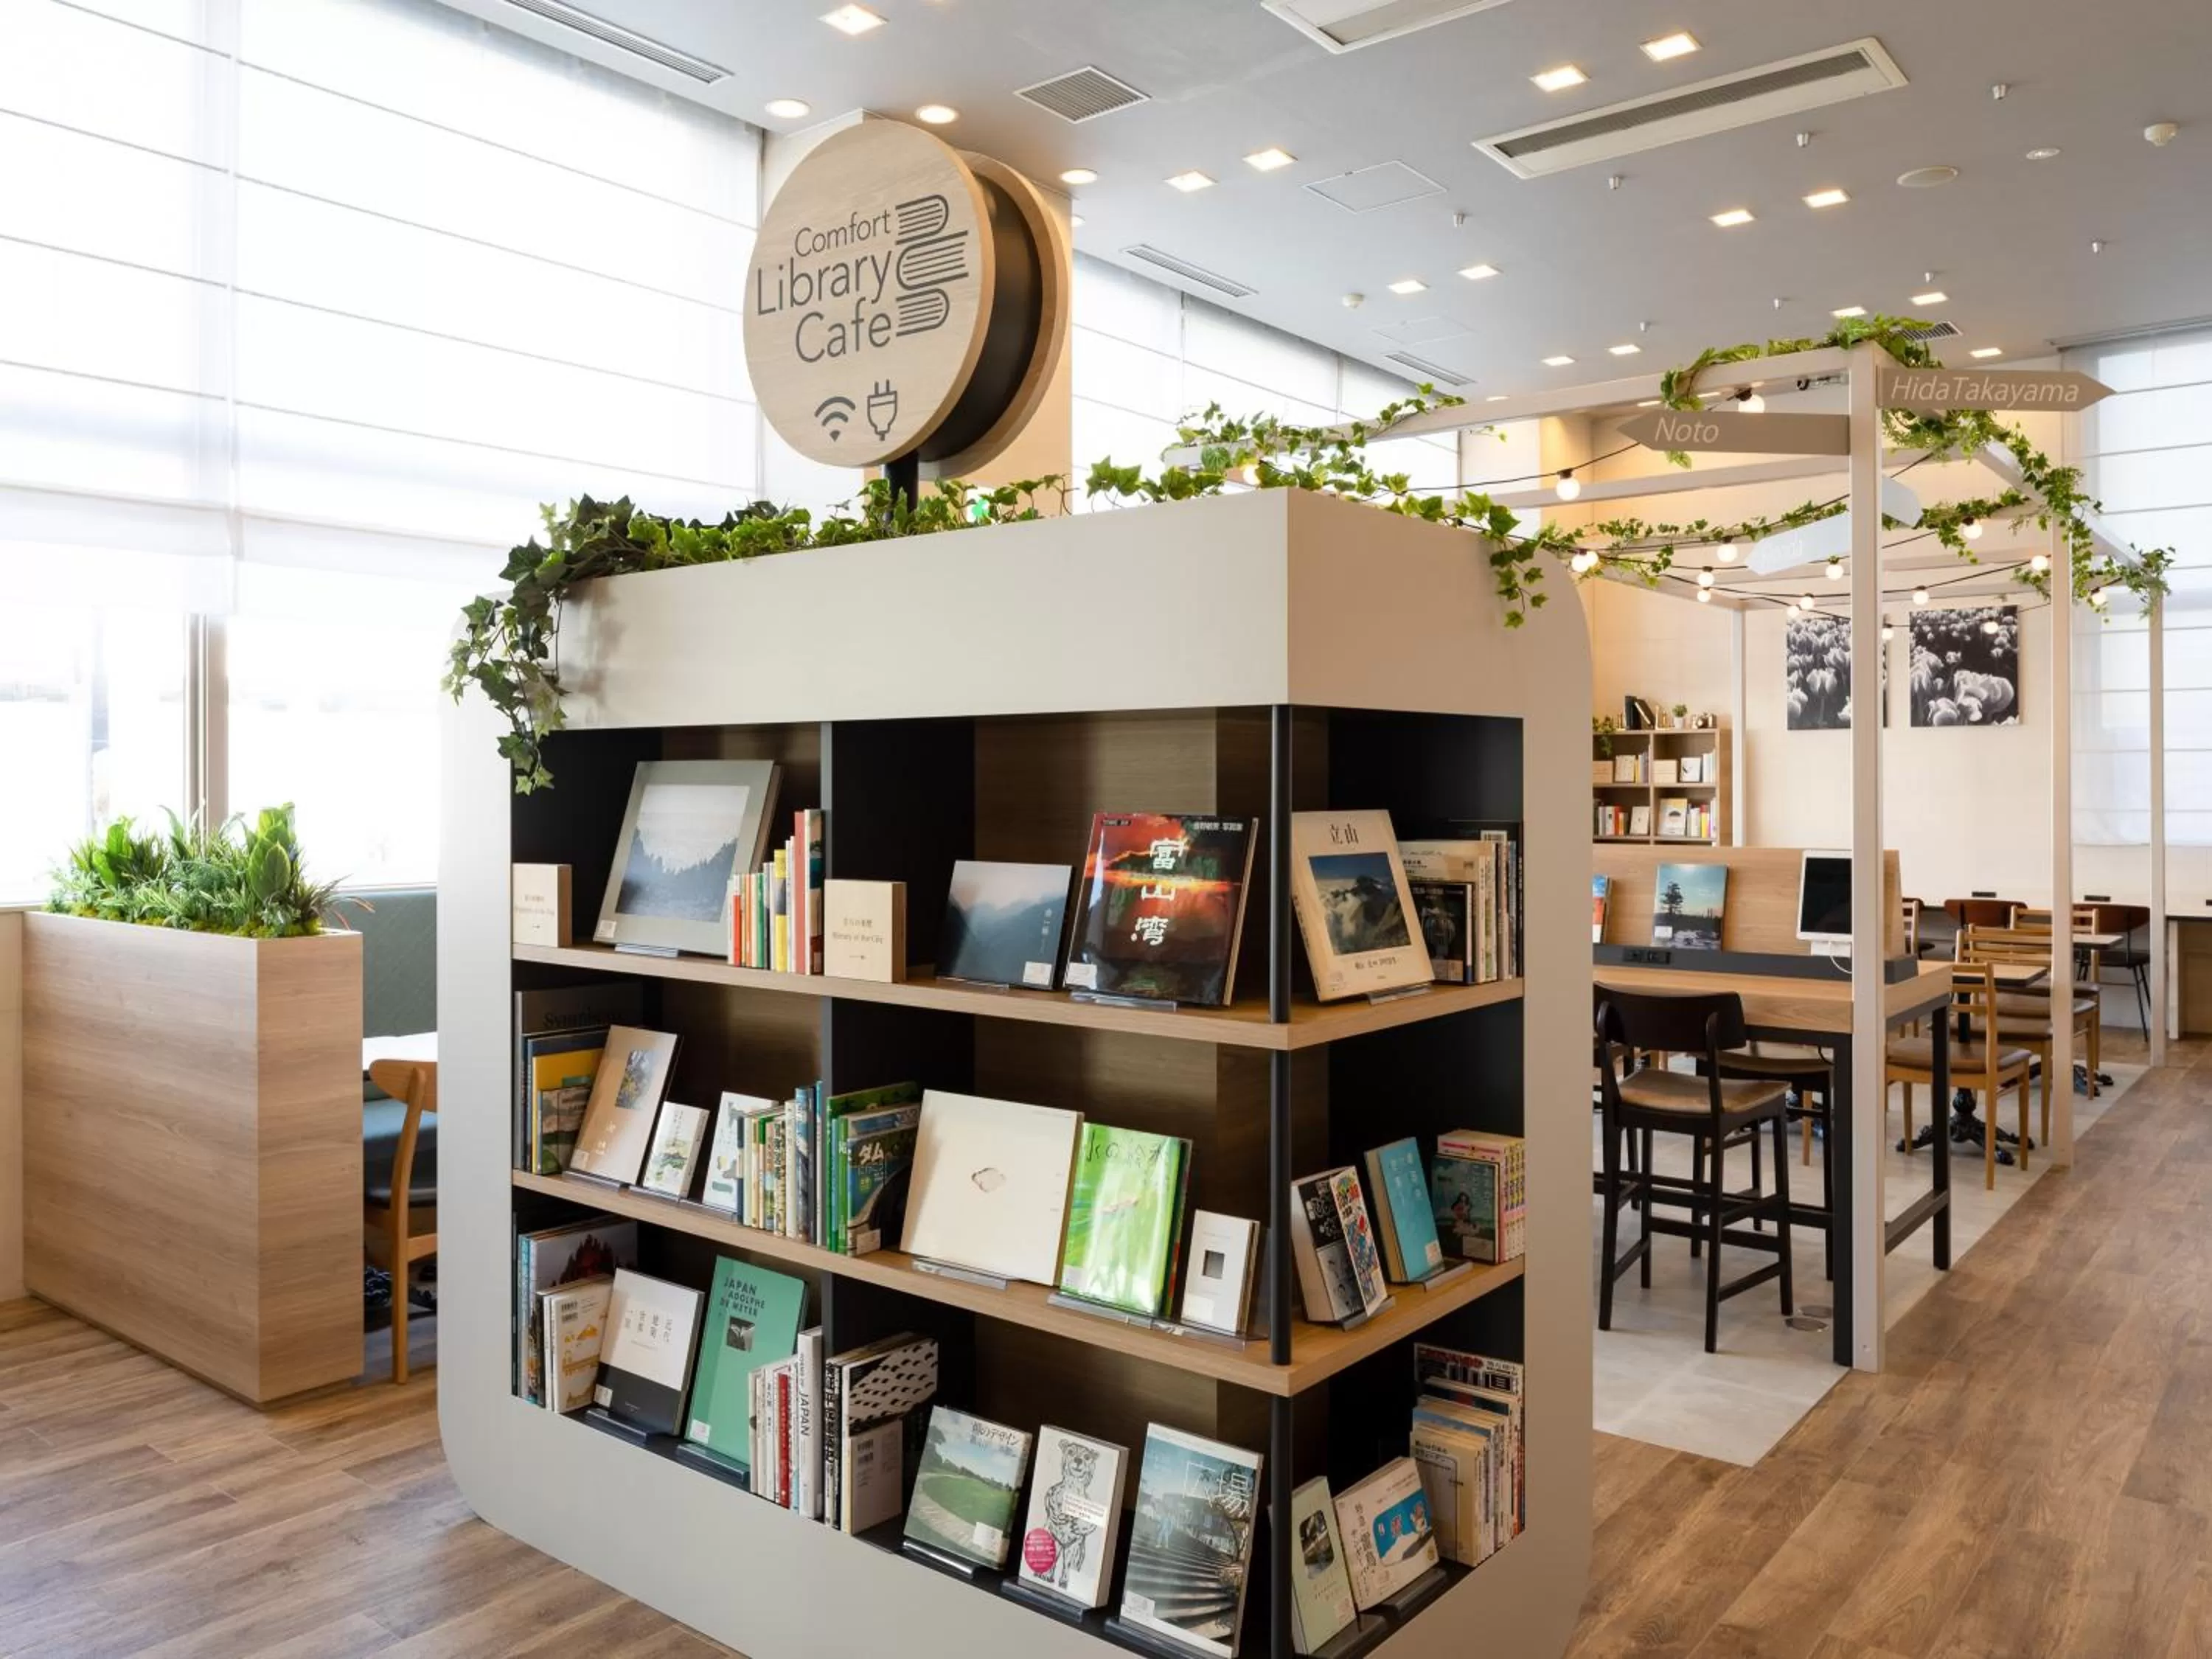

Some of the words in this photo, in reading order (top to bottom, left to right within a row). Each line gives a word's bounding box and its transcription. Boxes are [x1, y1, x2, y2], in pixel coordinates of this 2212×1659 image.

[794, 209, 891, 257] Comfort
[757, 249, 892, 316] Library
[796, 297, 891, 363] Cafe
[1891, 376, 2080, 408] HidaTakayama
[1655, 417, 1719, 444] Noto
[1329, 822, 1359, 845] 立山
[1130, 836, 1190, 946] 富山湾
[724, 1277, 757, 1295] JAPAN
[799, 1391, 810, 1437] JAPAN
